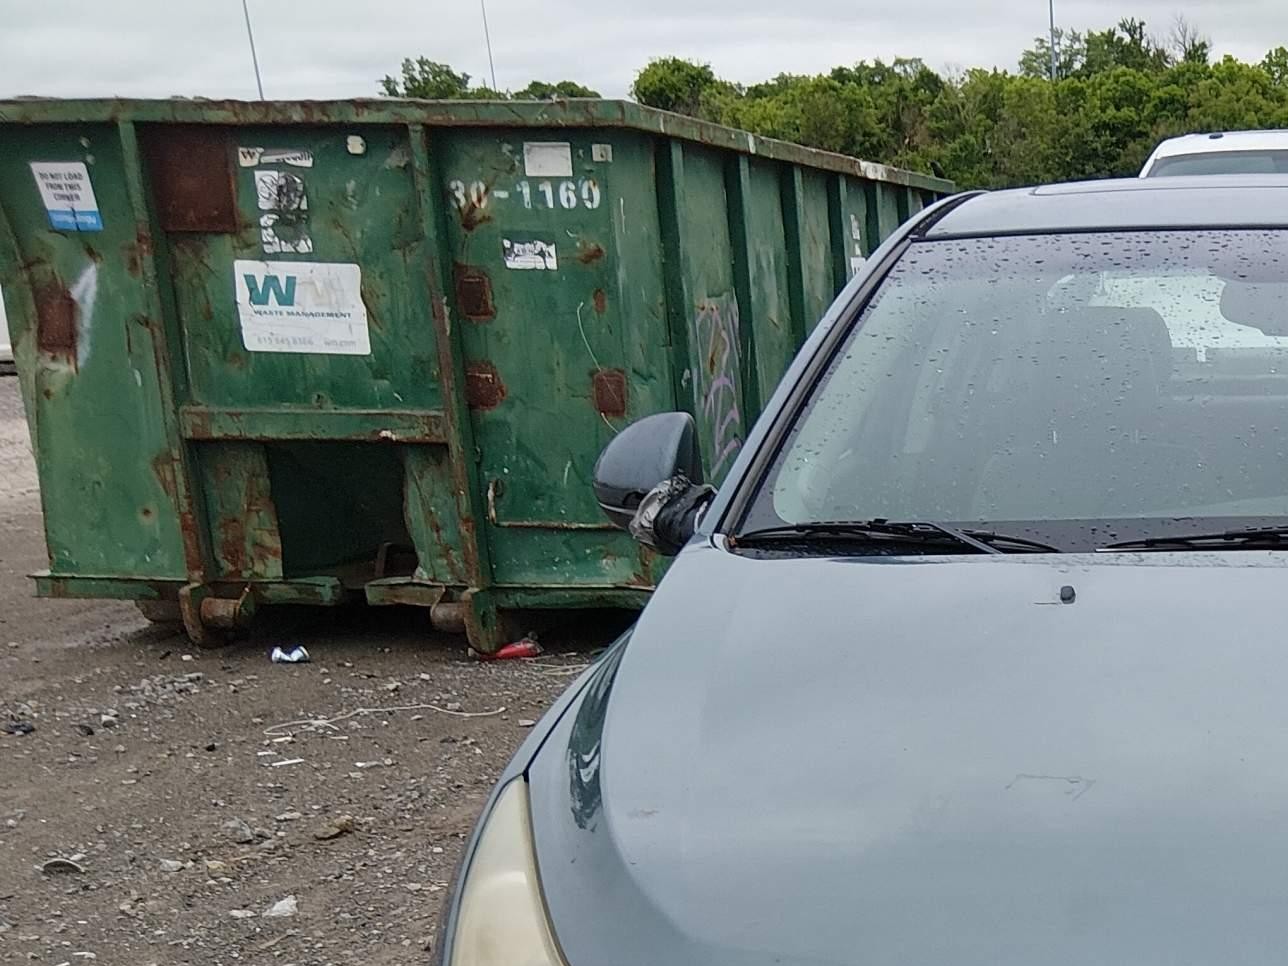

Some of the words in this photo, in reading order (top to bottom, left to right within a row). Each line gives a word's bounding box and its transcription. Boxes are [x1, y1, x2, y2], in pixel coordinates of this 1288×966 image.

[64, 172, 84, 181] LOAD
[45, 182, 64, 191] FROM
[449, 178, 601, 210] 30-1160
[286, 311, 352, 319] MANAGEMENT
